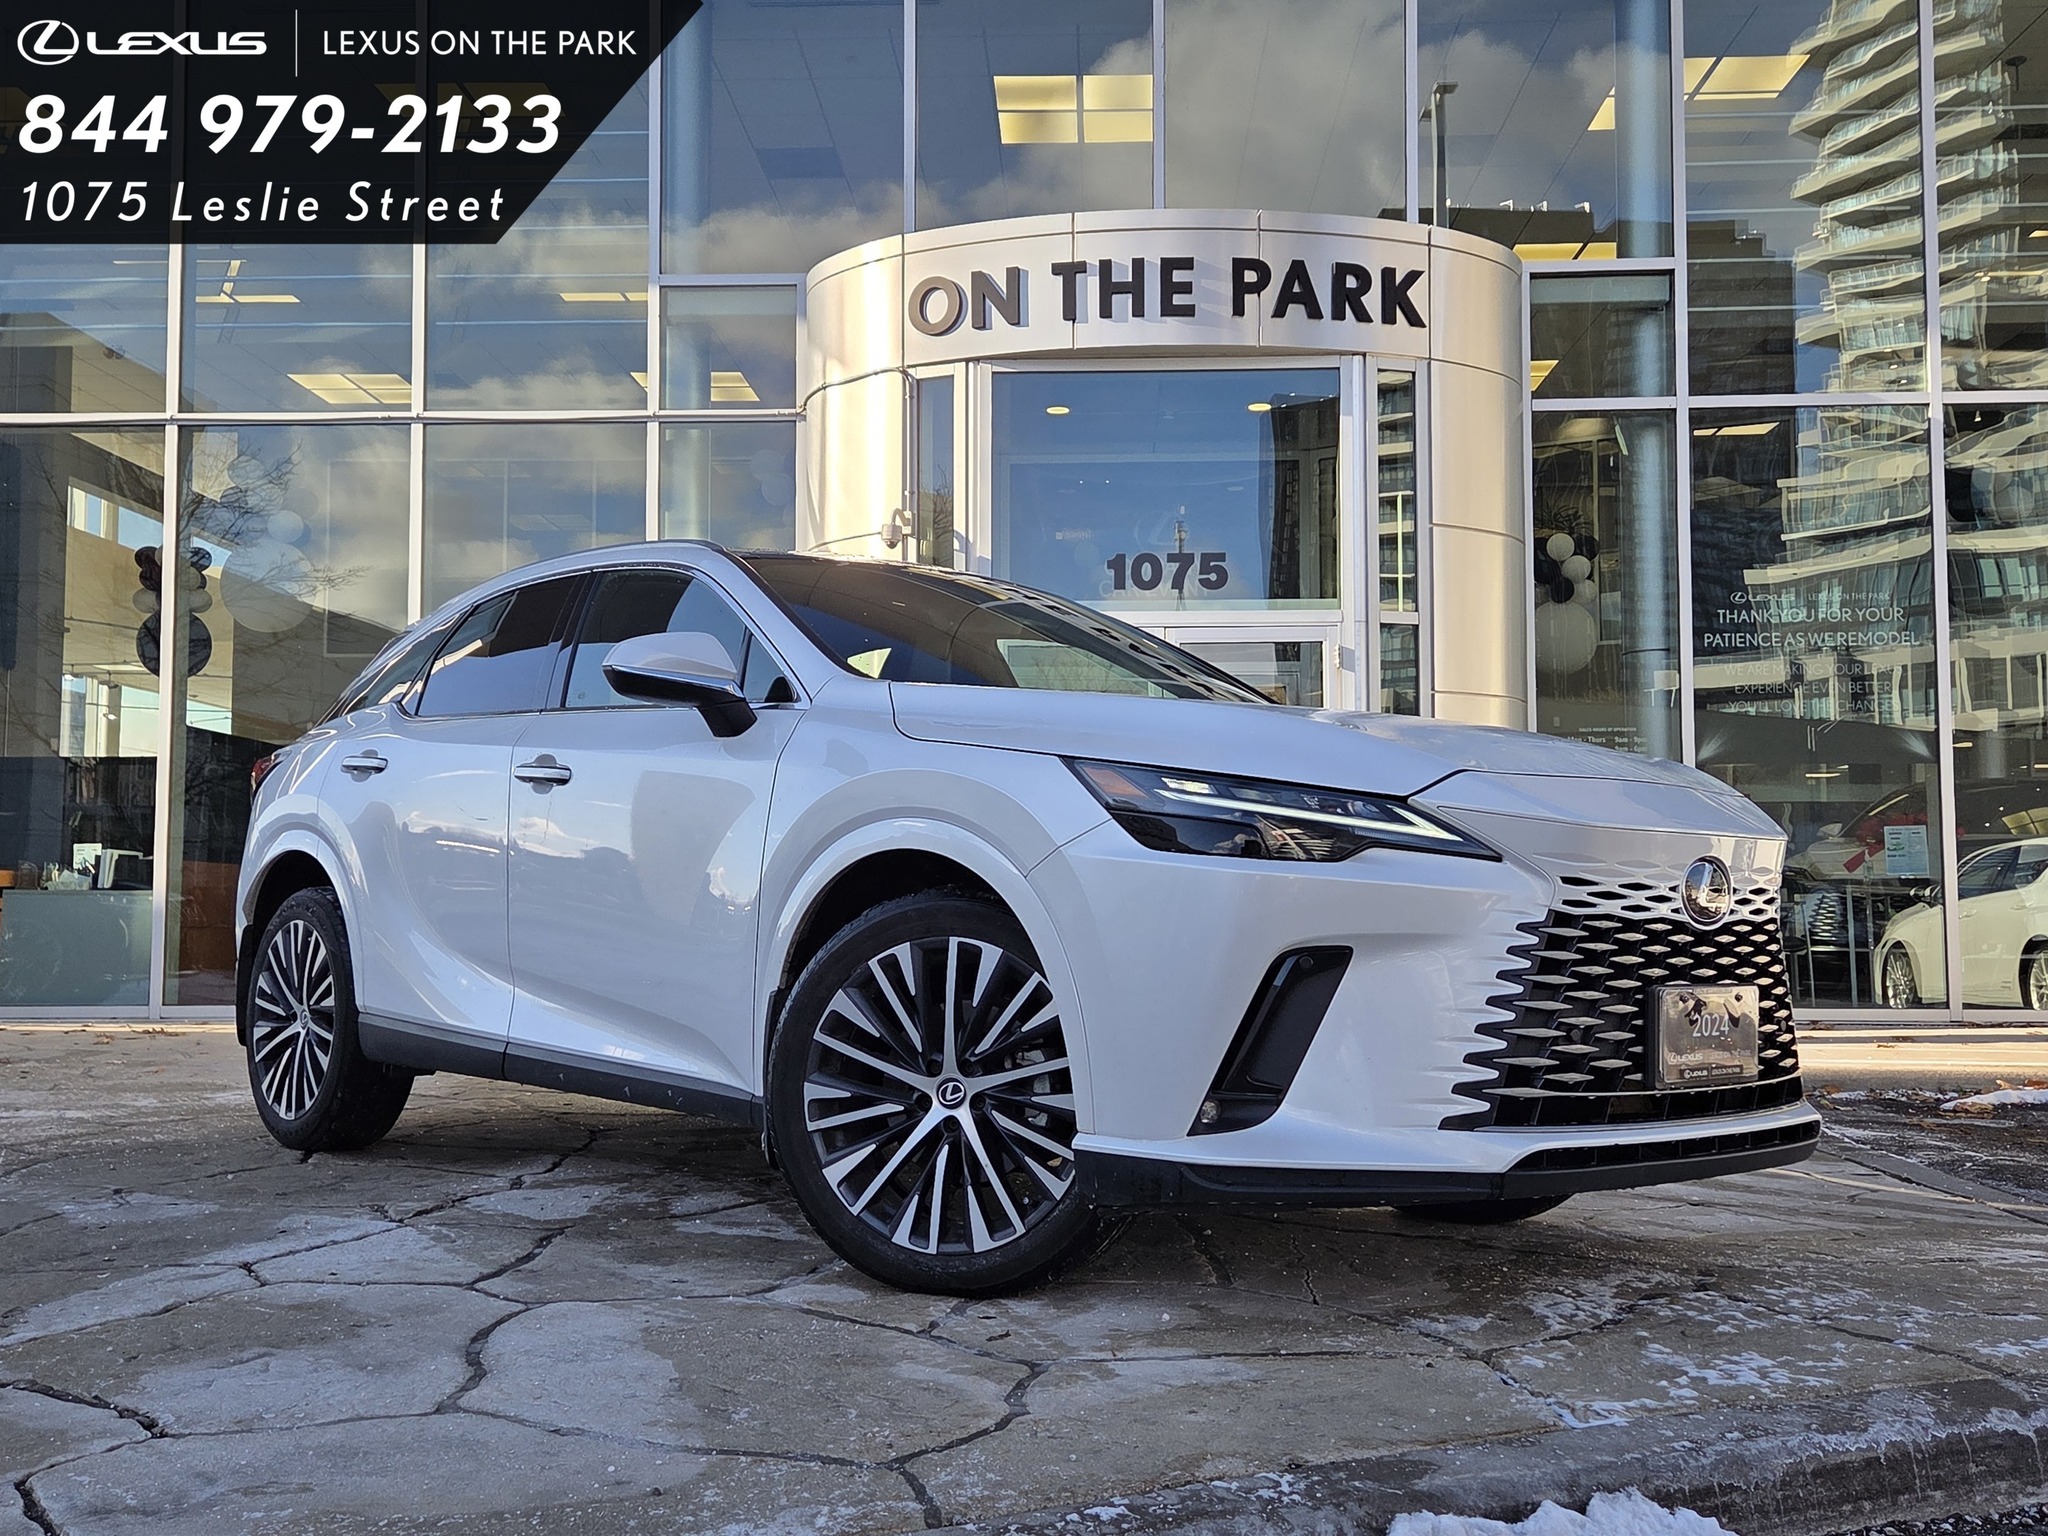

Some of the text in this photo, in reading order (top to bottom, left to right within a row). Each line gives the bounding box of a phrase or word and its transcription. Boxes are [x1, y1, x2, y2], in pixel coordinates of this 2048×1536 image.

[908, 256, 1428, 337] ON THE PARK
[1106, 552, 1229, 591] 1075
[1717, 607, 1905, 624] THANK YOU FOR YOUR
[1704, 631, 1920, 648] PATIENCE AS WE REMODEL
[1724, 665, 1743, 676] WE
[1746, 665, 1770, 676] ARE
[1773, 664, 1823, 676] MAKING
[1827, 663, 1862, 675] YOUR
[1734, 682, 1810, 694] EXPERIENCE
[1813, 682, 1846, 693] EVEN
[1775, 700, 1807, 712] LOVE
[1692, 1013, 1730, 1037] 2024
[1677, 1052, 1704, 1062] LEXUS
